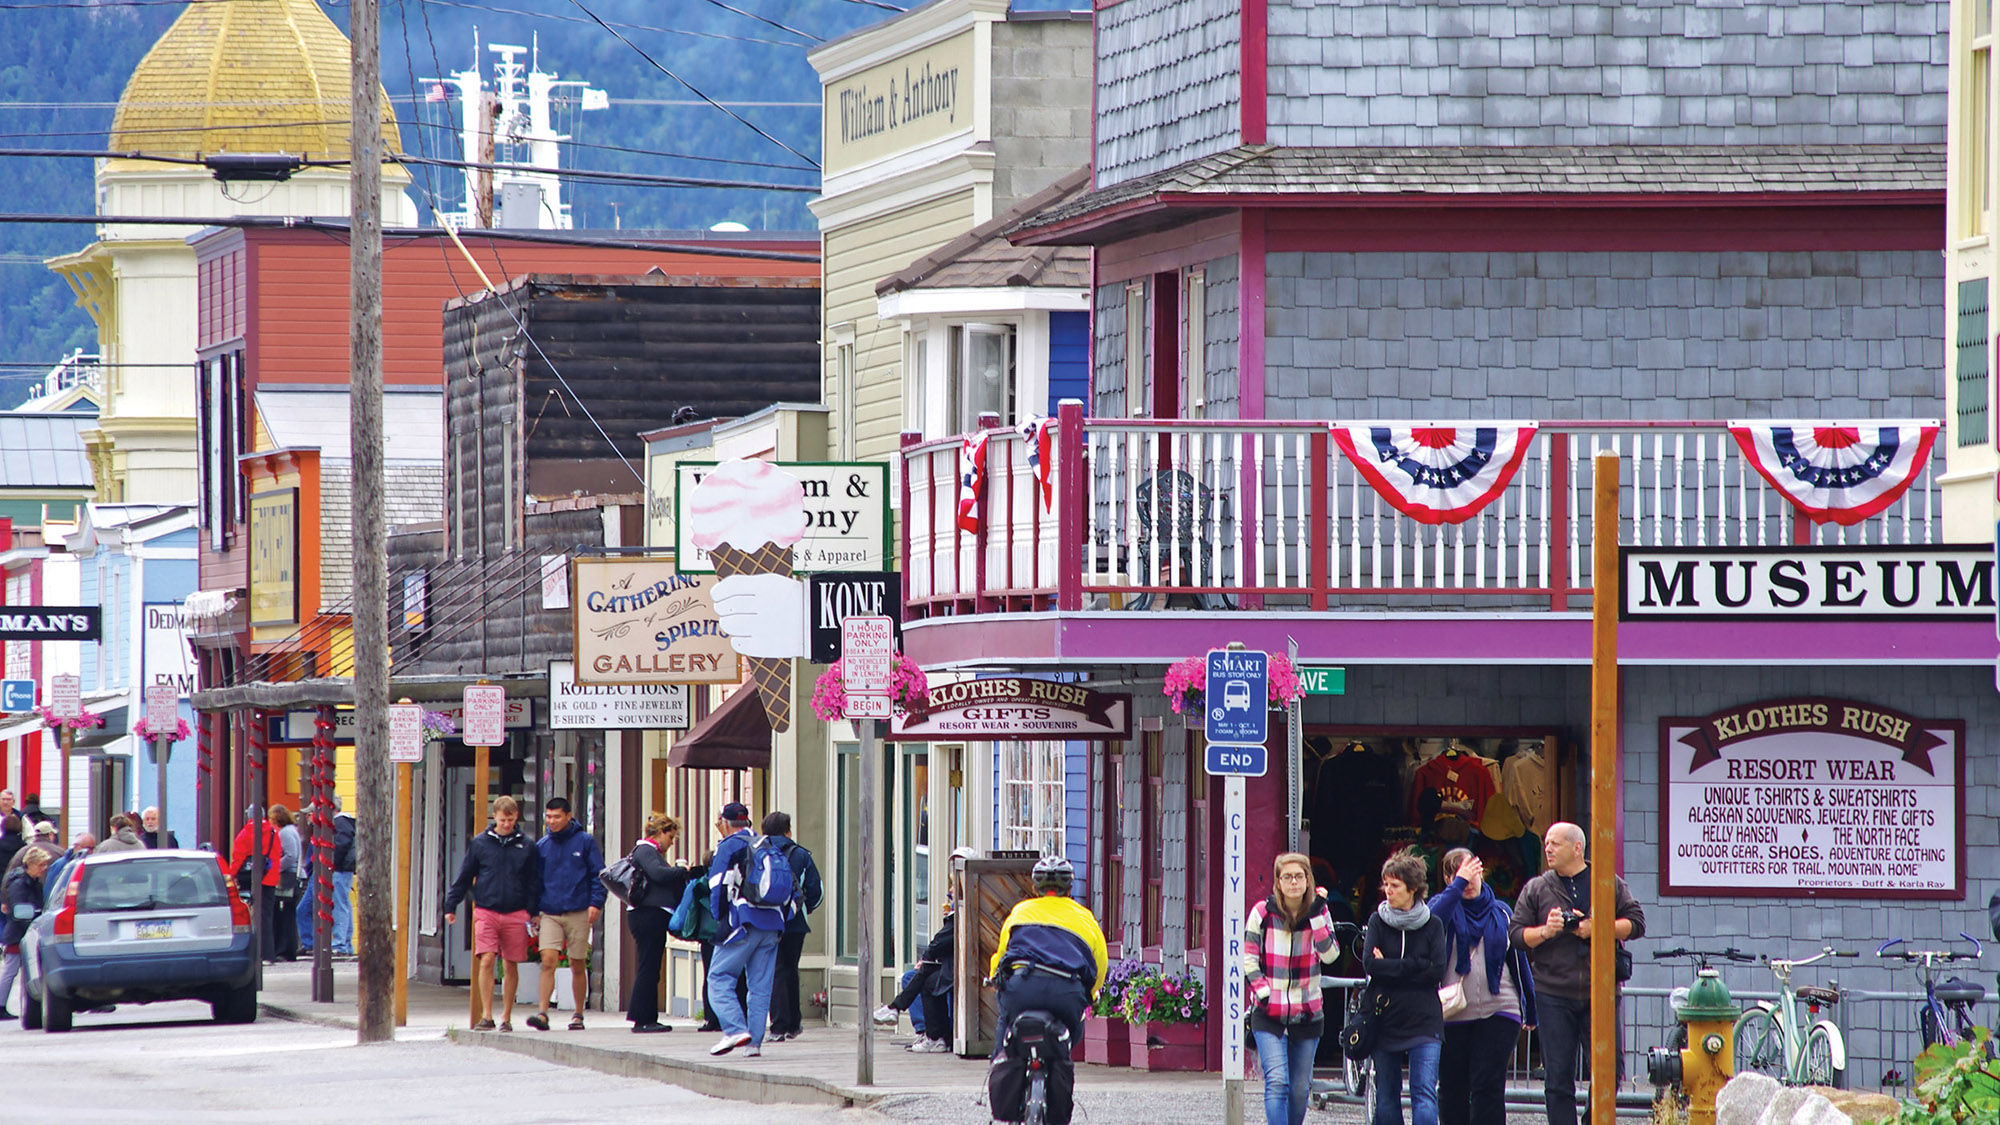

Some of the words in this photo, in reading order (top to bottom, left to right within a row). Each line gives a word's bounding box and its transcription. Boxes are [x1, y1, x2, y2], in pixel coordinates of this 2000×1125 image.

[840, 84, 885, 144] William
[889, 78, 898, 128] &
[902, 60, 959, 123] Anthony
[846, 473, 870, 498] &
[804, 550, 812, 562] &
[818, 549, 867, 566] Apparel
[586, 573, 701, 614] GATHERING
[1638, 560, 1996, 608] MUSEUM
[0, 614, 89, 633] MAN'S
[149, 608, 185, 629] DEDM
[851, 624, 854, 632] 1
[857, 624, 884, 632] HOUR
[854, 640, 880, 648] ONLY
[592, 652, 724, 674] GALLERY
[1213, 659, 1262, 671] SMART
[1300, 672, 1328, 691] AVE
[928, 679, 1021, 707] KLOTHES
[1030, 680, 1089, 707] RUSH
[553, 701, 568, 710] 14K
[572, 701, 597, 710] GOLD
[614, 701, 638, 710] FINE
[639, 701, 684, 710] JEWELRY
[853, 701, 882, 711] BEGIN
[946, 700, 972, 710] LOCALLY
[962, 707, 1051, 720] GIFTS
[554, 714, 596, 724] T-SHIRTS
[618, 714, 684, 724] SOUVENIERS
[939, 721, 977, 730] RESORT
[981, 721, 1010, 730] WEAR
[1022, 721, 1078, 730] SOUVENIRS
[1713, 704, 1829, 741] KLOTHES
[1841, 706, 1912, 742] RUSH
[1220, 753, 1252, 766] END
[1727, 759, 1817, 780] RESORT
[1827, 760, 1896, 781] WEAR
[1704, 787, 1750, 805] UNIQUE
[1754, 787, 1809, 806] T-SHIRTS
[1813, 788, 1825, 806] &
[1828, 788, 1917, 808] SWEATSHIRTS
[1688, 806, 1743, 823] ALASKAN
[1873, 809, 1898, 826] FINE
[1901, 809, 1935, 826] GIFTS
[1702, 825, 1733, 843] HELLY
[1736, 826, 1778, 843] HANSEN
[1833, 827, 1853, 845] THE
[1855, 827, 1892, 846] NORTH
[1894, 828, 1920, 846] FACE
[1230, 813, 1240, 893] CITY
[1677, 844, 1729, 858] OUTDOOR
[1829, 847, 1892, 861] ADVENTURE
[1894, 848, 1946, 862] CLOTHING
[1768, 862, 1788, 875] FOR
[1797, 879, 1853, 889] Proprietors
[1229, 918, 1239, 1062] TRANSIT
